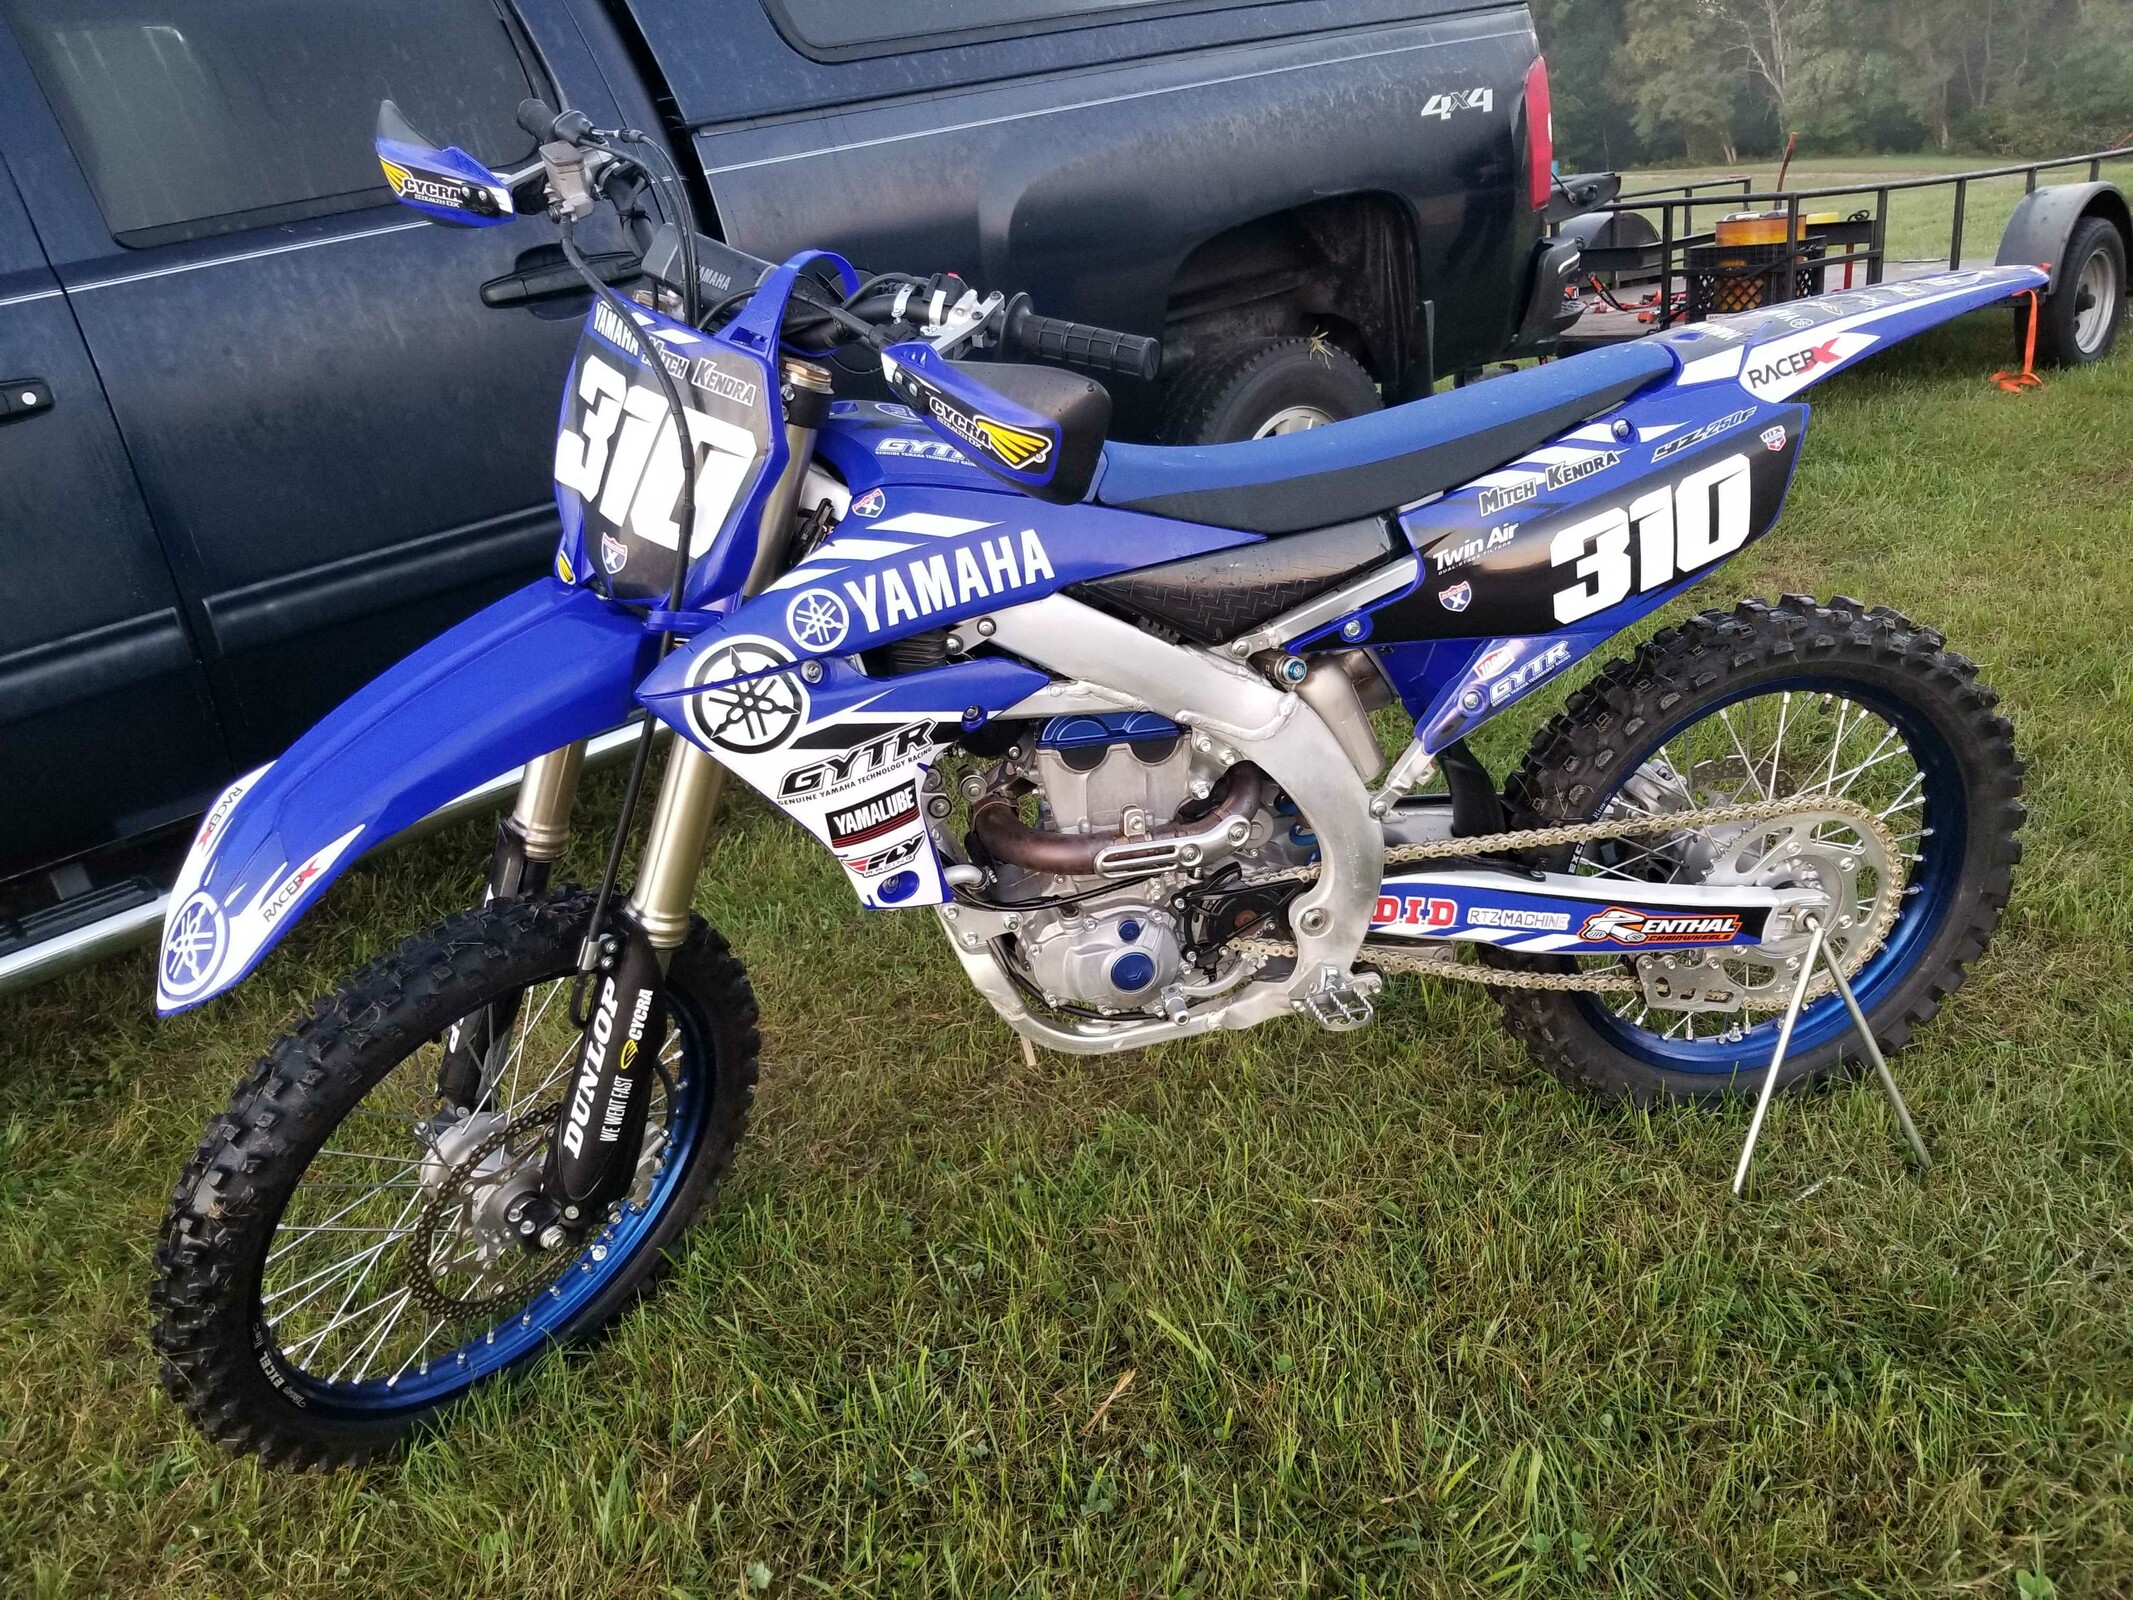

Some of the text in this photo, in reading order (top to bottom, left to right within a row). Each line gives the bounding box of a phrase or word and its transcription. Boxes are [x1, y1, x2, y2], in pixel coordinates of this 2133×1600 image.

[403, 179, 461, 200] CYCRA
[699, 265, 731, 291] AMAHA
[692, 358, 757, 407] KENDRA
[930, 397, 991, 449] CYCRA
[937, 415, 983, 451] STEALTH DX
[554, 355, 757, 559] 310
[1480, 451, 1620, 516] MITCH KENDRA
[1433, 523, 1519, 570] Twin Air
[1439, 541, 1511, 575] DUAL-STAGE FILTERS
[1549, 453, 1751, 625] 310
[844, 529, 1054, 633] YAMAHA
[1490, 640, 1570, 704] GYTR
[777, 718, 936, 798] GYTR
[778, 747, 932, 805] GENUINE YAMAHA TECHNOLOGY RACING
[833, 786, 915, 836] YAMALUBE
[865, 856, 913, 875] RACING
[867, 835, 924, 870] FLY
[1503, 911, 1567, 928] MACHINE
[1583, 910, 1735, 943] RENTHAL
[629, 988, 653, 1041] CYCRA
[563, 977, 619, 1159] DUNLOP
[599, 1075, 633, 1142] WE WENT FAST
[259, 1351, 285, 1389] EXCEL
